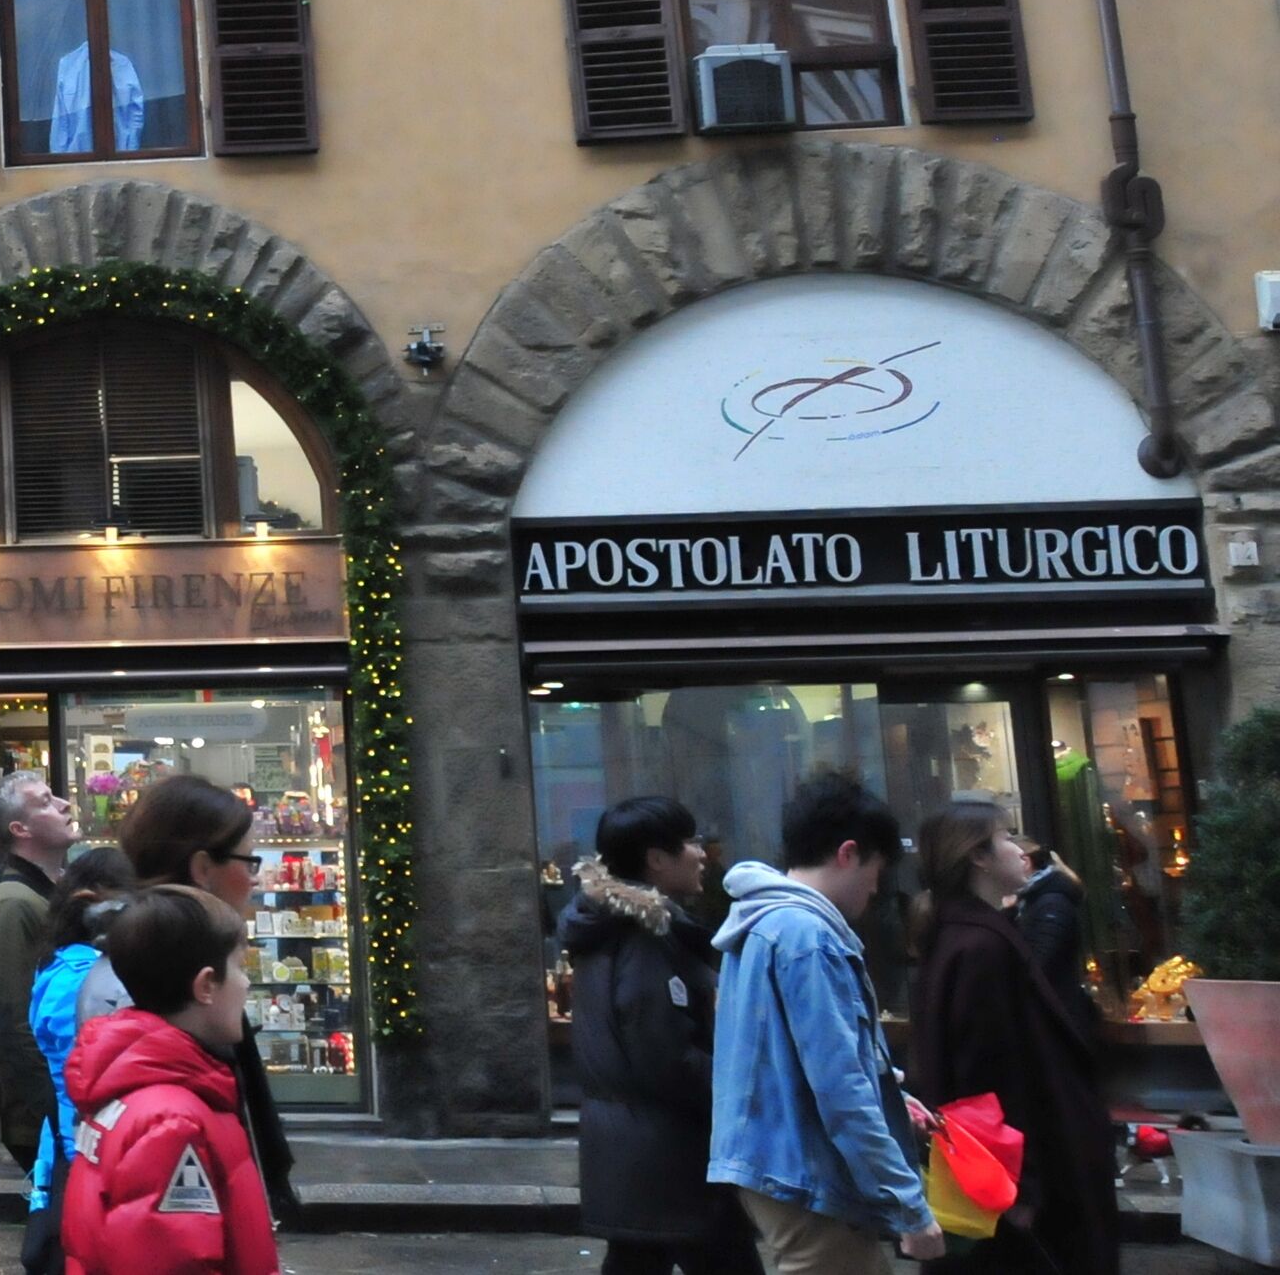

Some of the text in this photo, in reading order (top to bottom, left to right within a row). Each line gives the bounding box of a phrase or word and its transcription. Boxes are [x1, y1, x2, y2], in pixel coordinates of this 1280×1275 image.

[523, 524, 1199, 592] APOSTOLATO LITURGICO
[100, 570, 308, 610] FIRENZE
